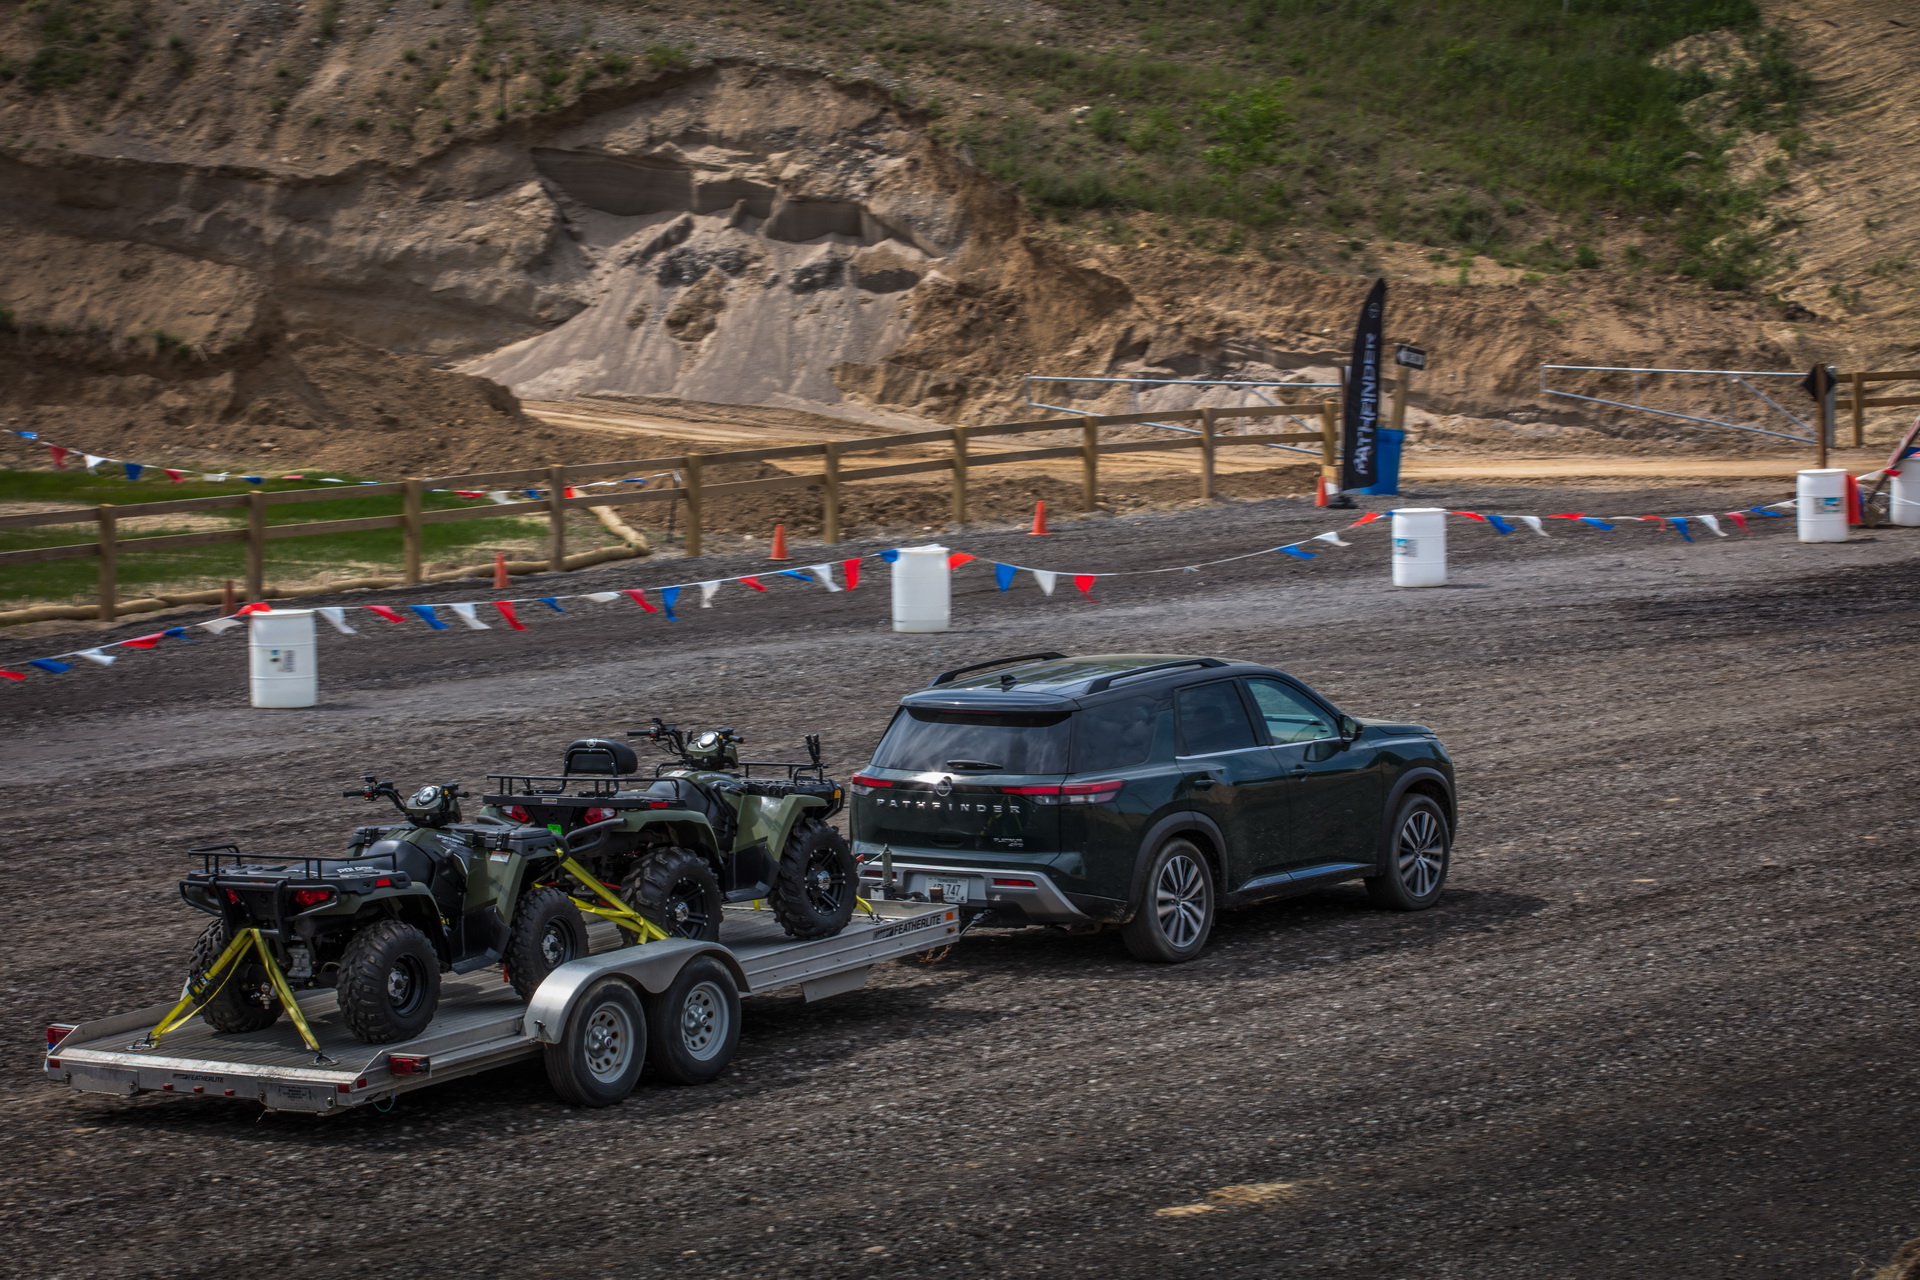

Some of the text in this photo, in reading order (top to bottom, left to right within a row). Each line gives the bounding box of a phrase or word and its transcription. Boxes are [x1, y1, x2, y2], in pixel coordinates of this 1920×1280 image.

[1353, 333, 1377, 475] PATHFINDER
[876, 798, 1021, 814] PATHFINDER
[893, 914, 942, 936] FEATHERLITE
[188, 1074, 224, 1083] FEATHERLITE
